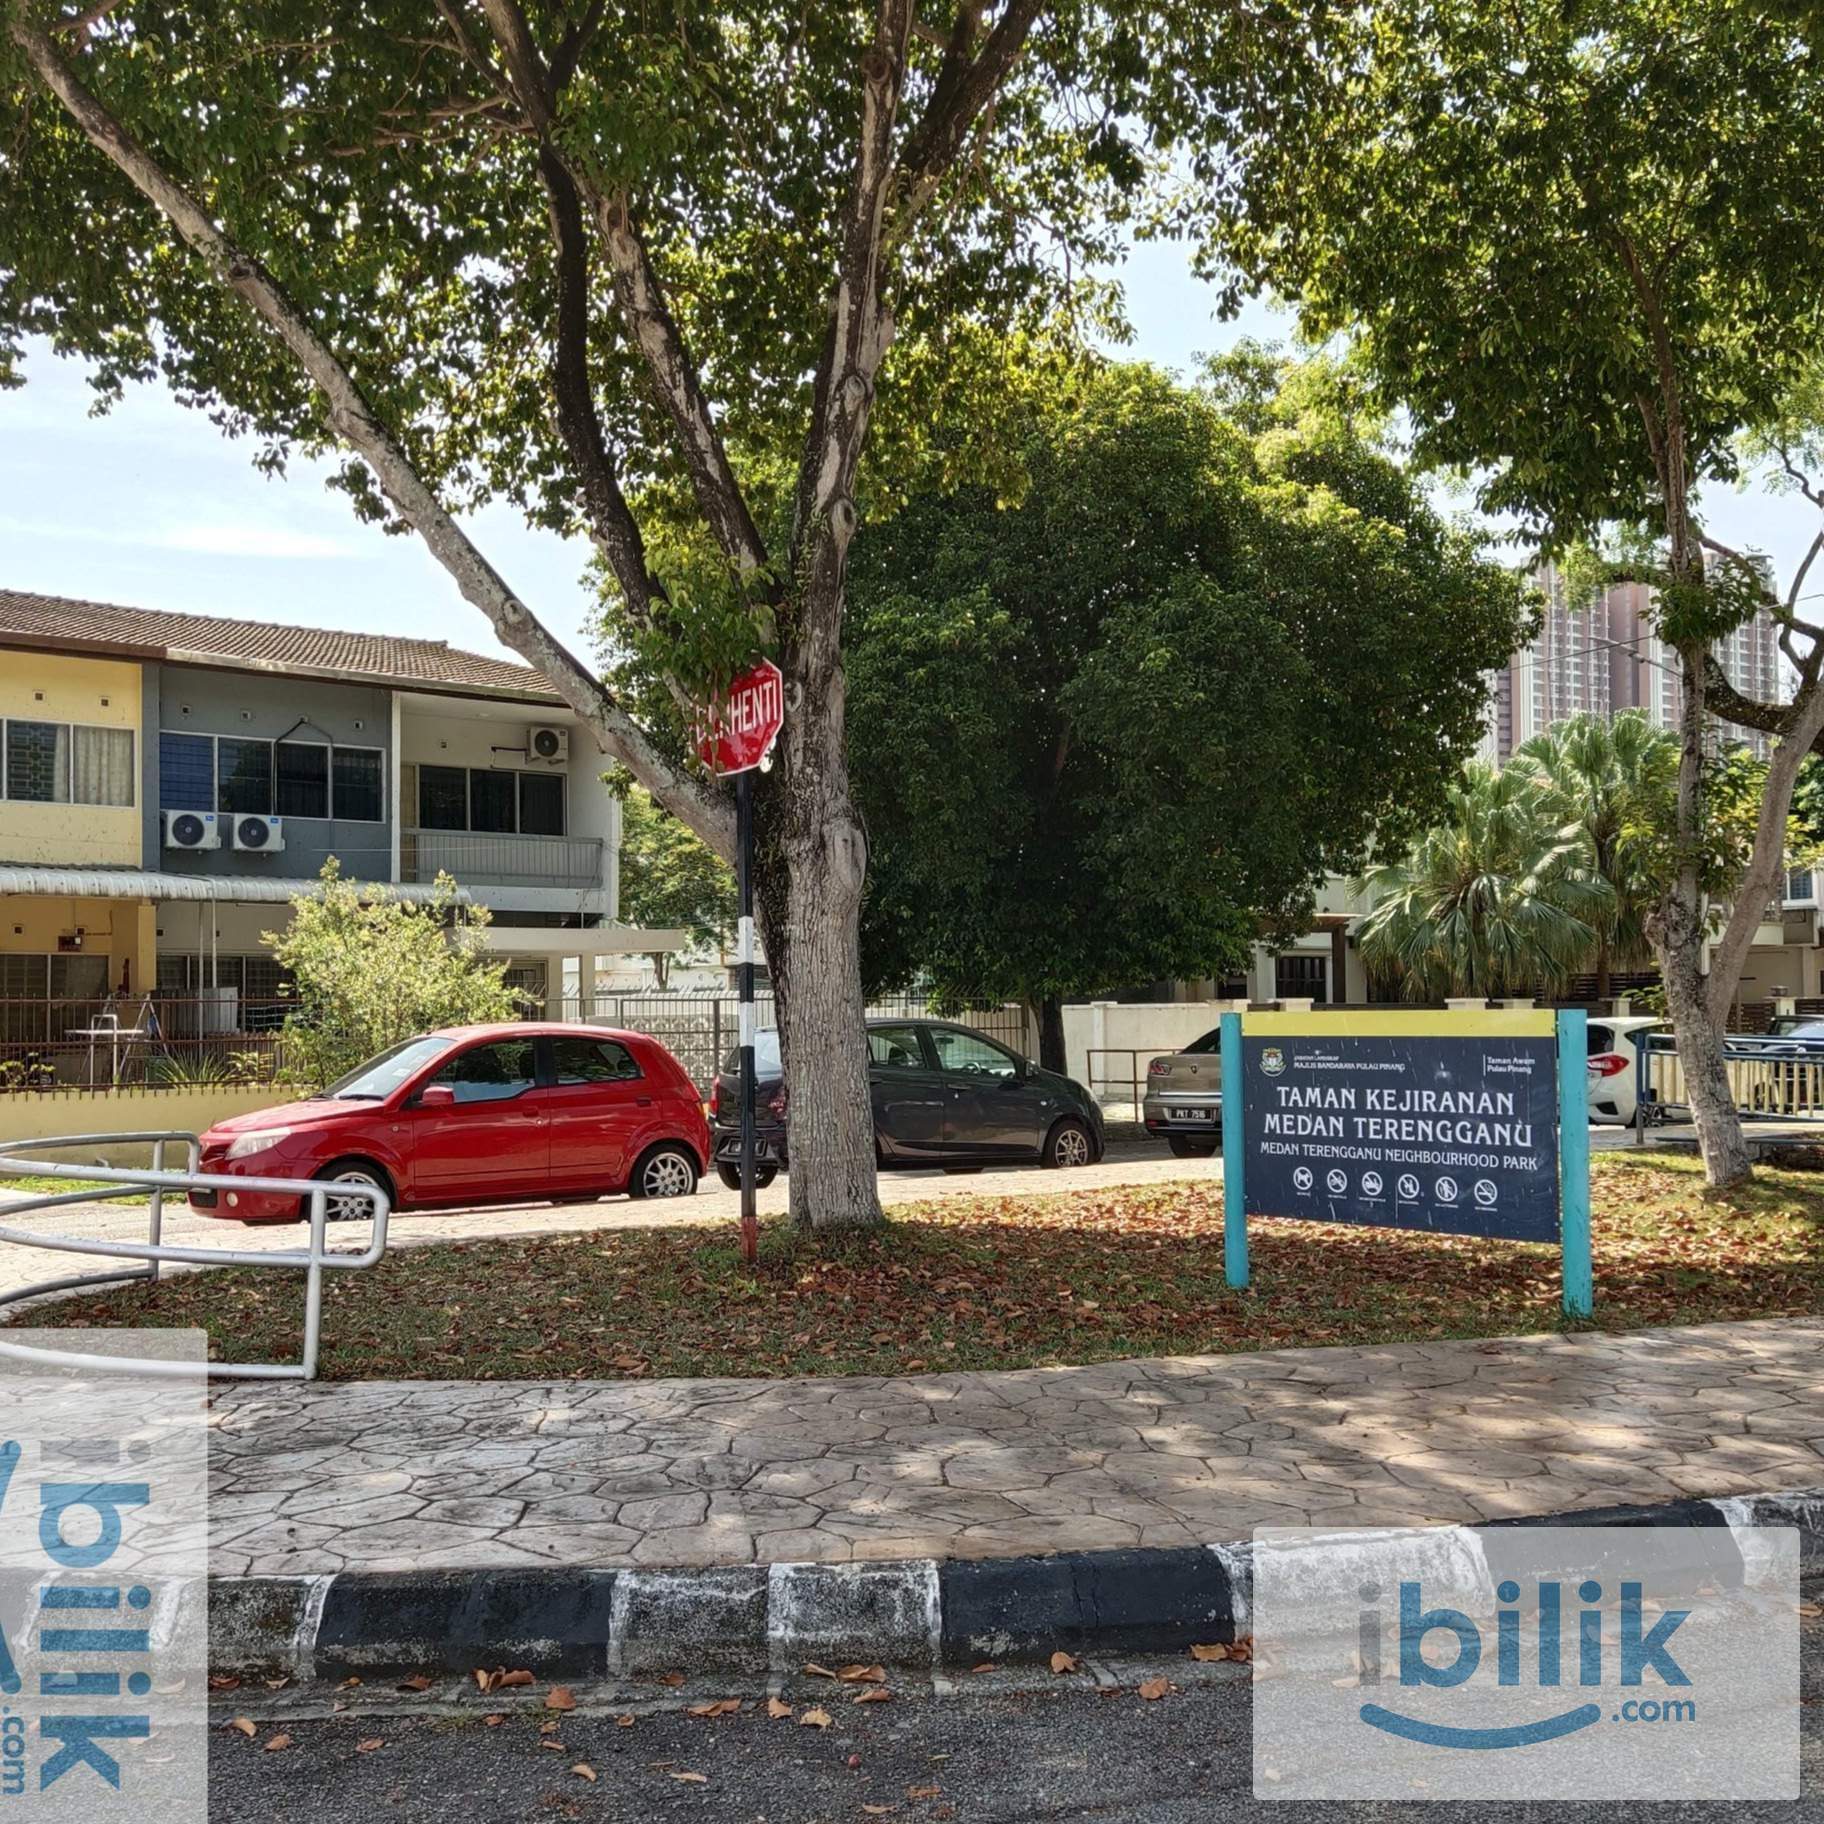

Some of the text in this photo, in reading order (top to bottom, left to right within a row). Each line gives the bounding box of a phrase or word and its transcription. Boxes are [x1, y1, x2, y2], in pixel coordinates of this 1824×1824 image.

[1276, 1086, 1515, 1115] TAMAN KEJIRANAN
[1264, 1113, 1533, 1148] MEDAN TERENGGANU
[1260, 1142, 1538, 1171] MEDAN TERENGGANU NEIGHBOURHOOD PARK
